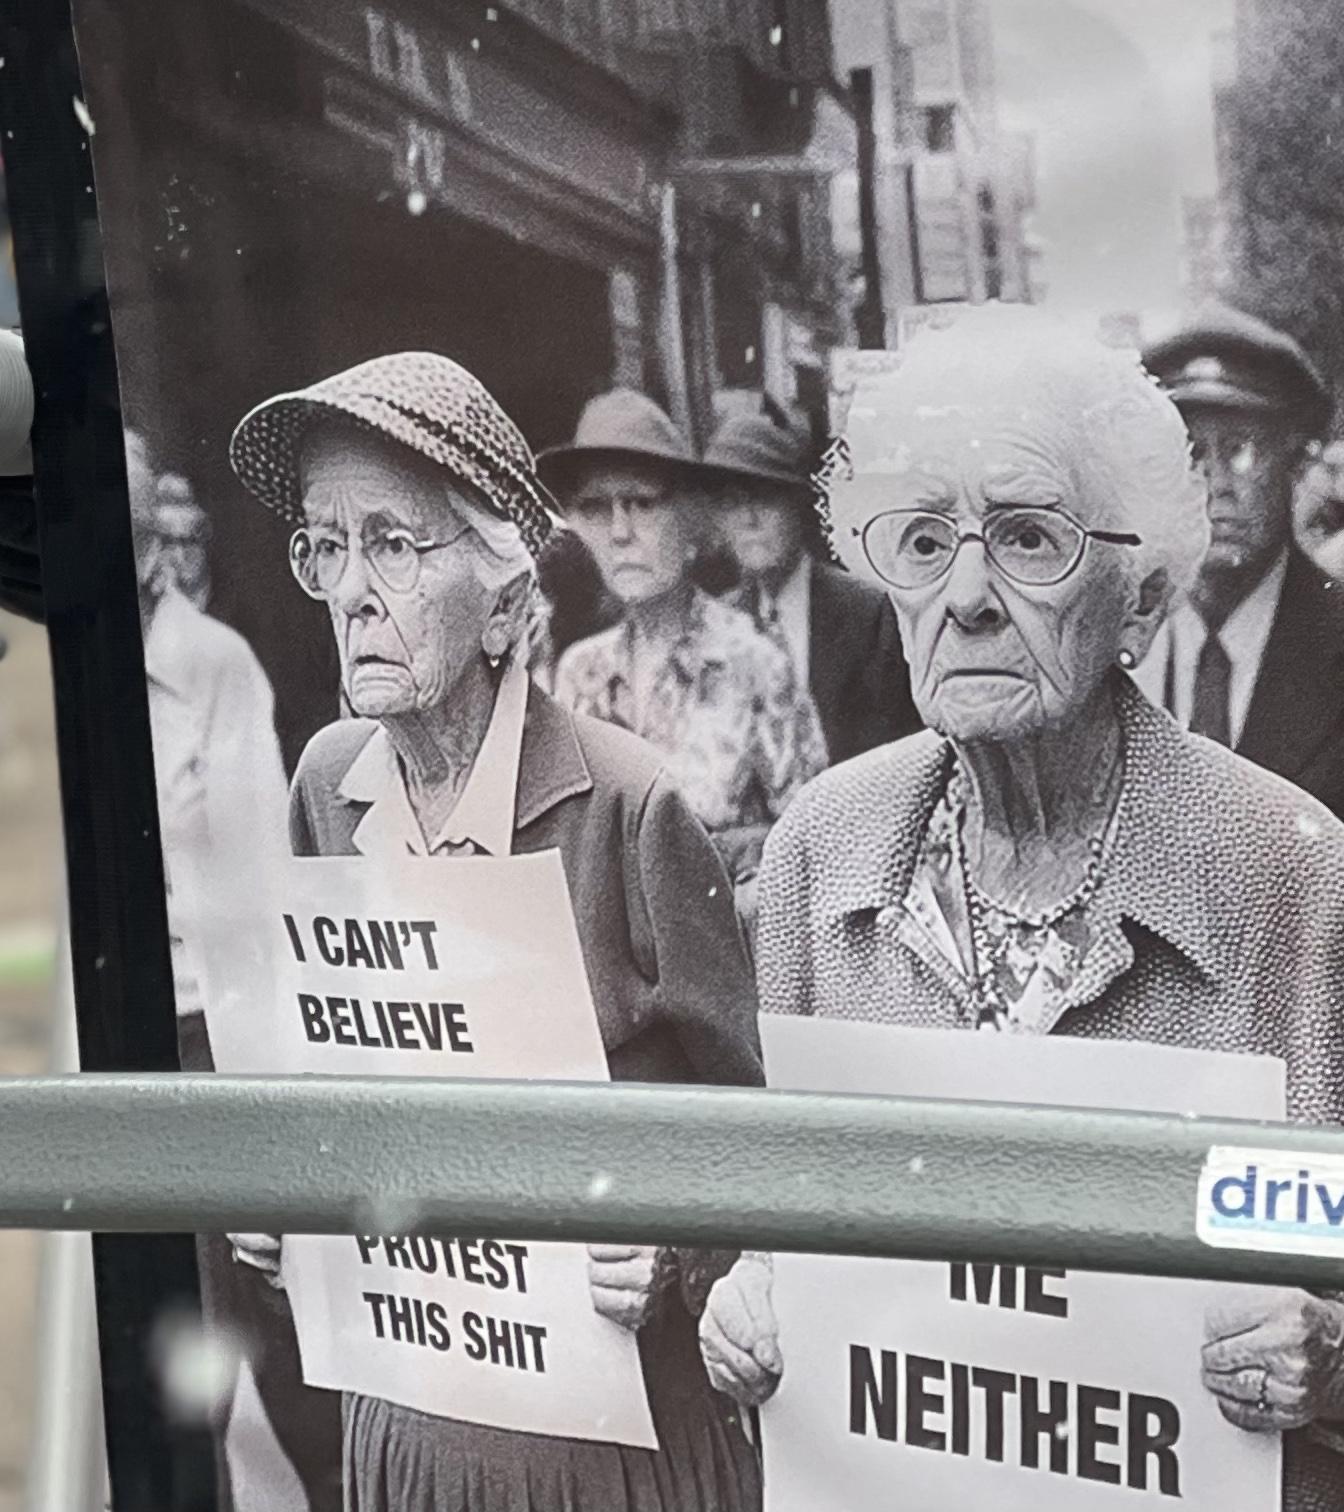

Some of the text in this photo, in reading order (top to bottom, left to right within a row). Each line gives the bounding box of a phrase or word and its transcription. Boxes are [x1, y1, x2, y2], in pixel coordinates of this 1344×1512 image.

[282, 913, 439, 970] I CAN'T
[297, 993, 474, 1053] BELIEVE
[355, 1236, 529, 1294] PROTEST
[362, 1292, 547, 1374] THIS SHIT
[849, 1343, 1183, 1498] NEITHER
